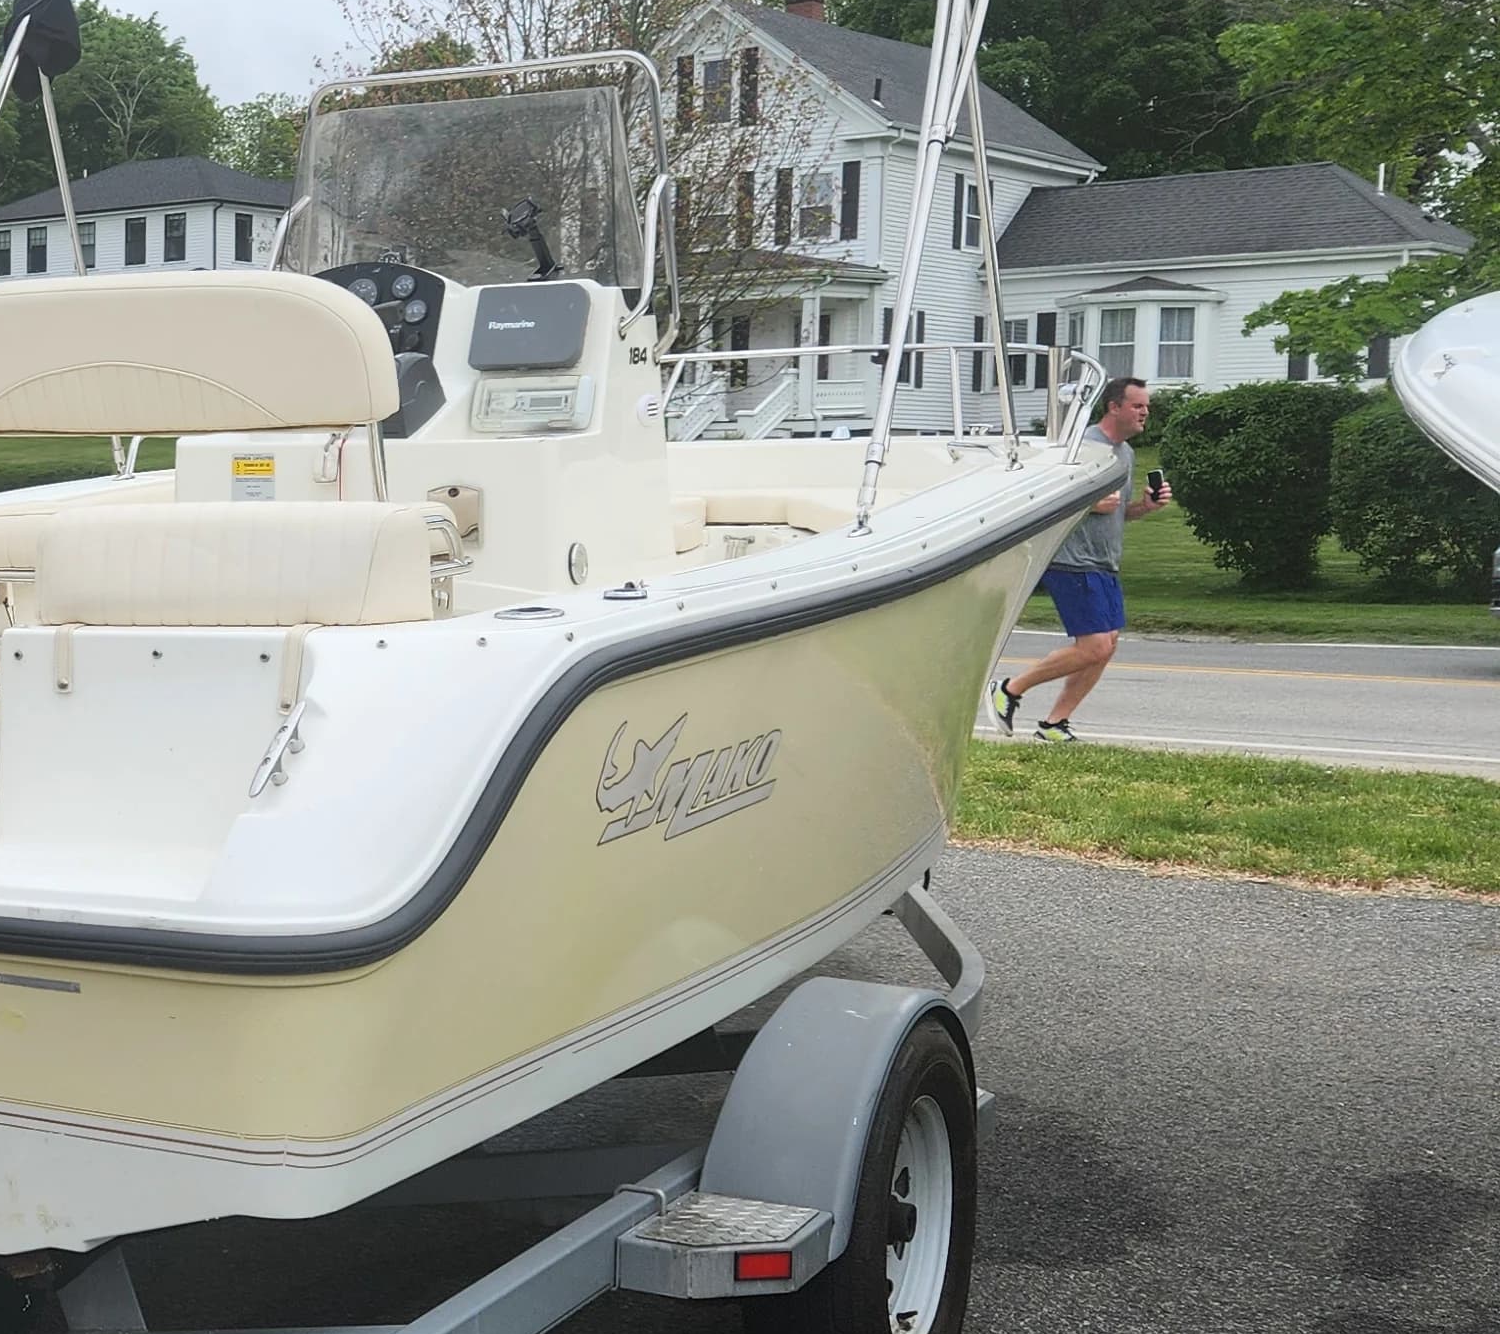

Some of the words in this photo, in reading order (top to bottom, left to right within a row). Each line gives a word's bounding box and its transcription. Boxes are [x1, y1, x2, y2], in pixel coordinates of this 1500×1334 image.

[488, 319, 536, 331] Raymarine
[629, 347, 647, 365] 184
[650, 728, 782, 841] MAKO
